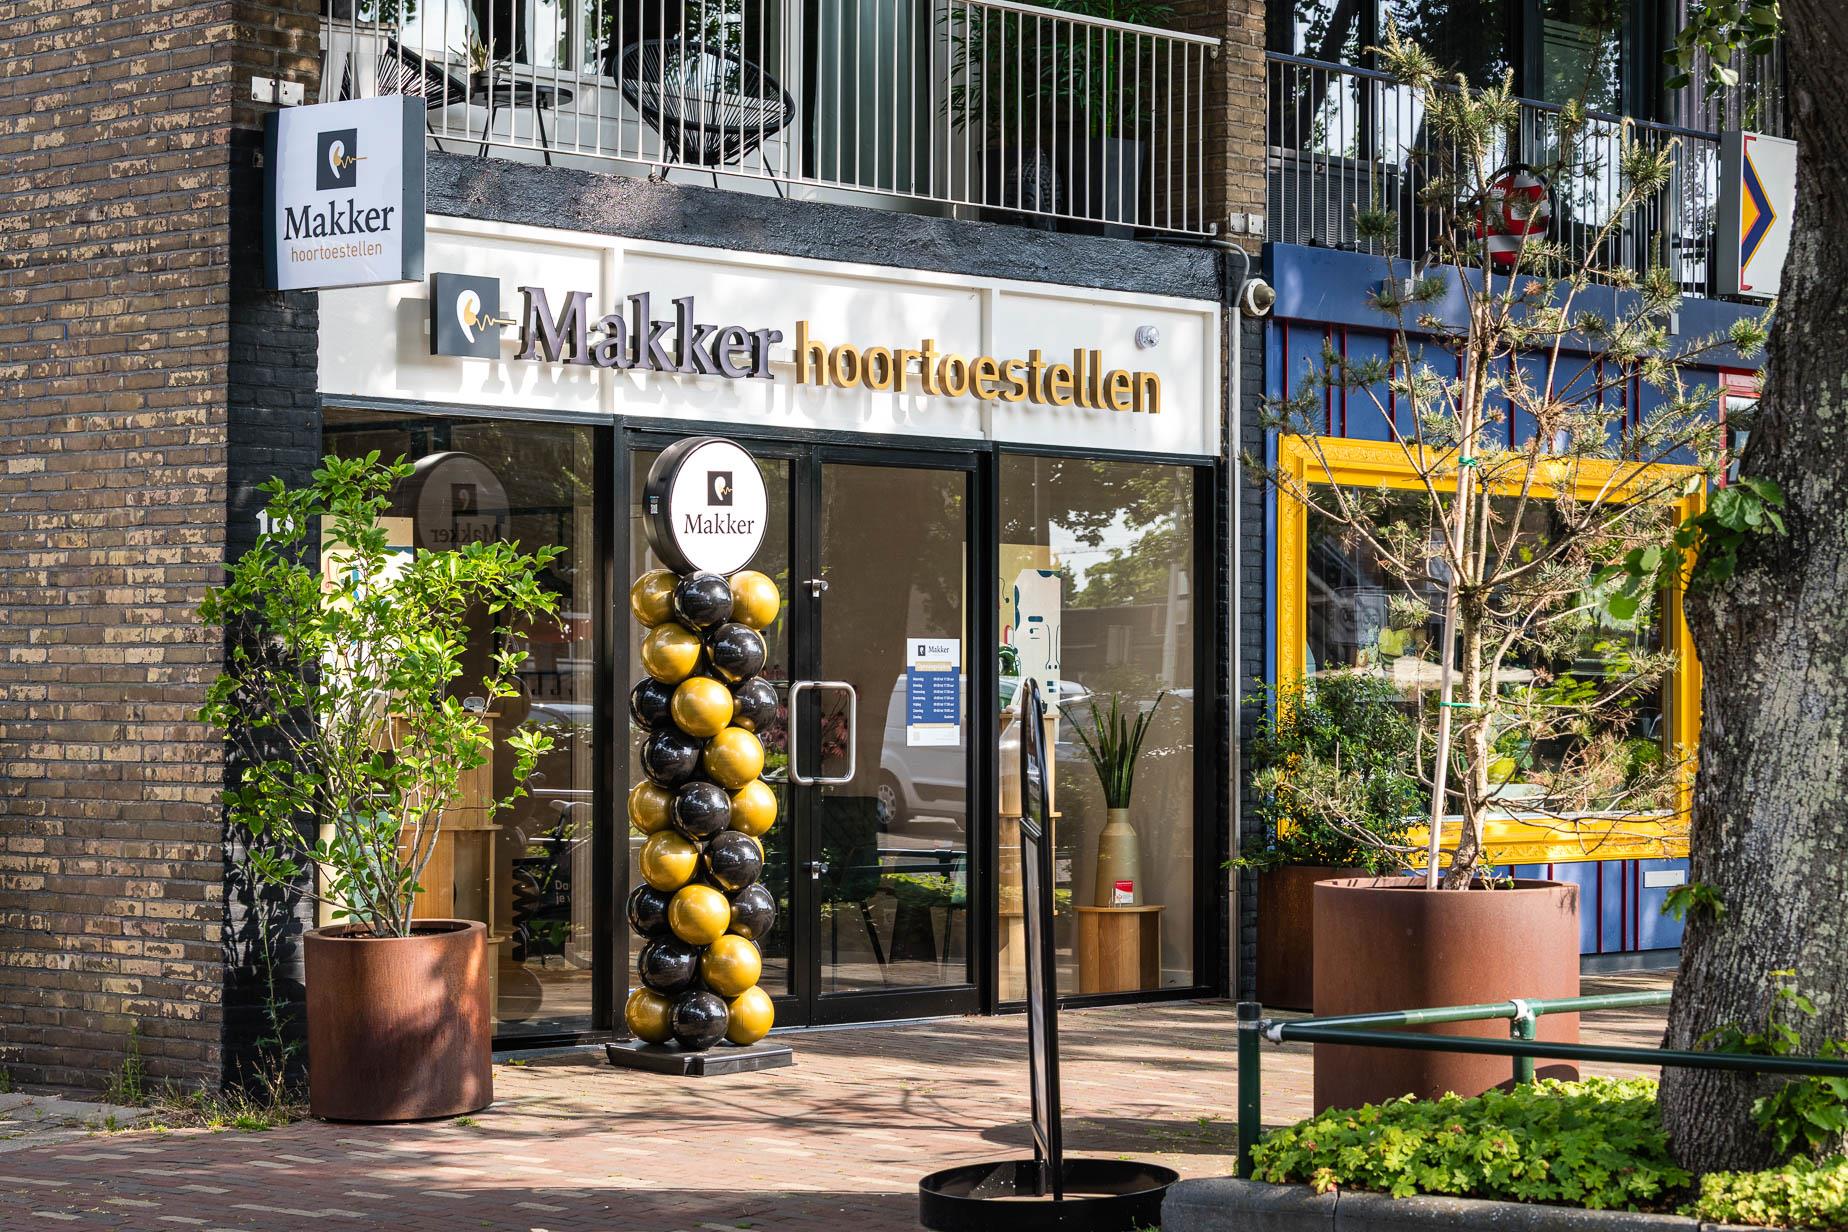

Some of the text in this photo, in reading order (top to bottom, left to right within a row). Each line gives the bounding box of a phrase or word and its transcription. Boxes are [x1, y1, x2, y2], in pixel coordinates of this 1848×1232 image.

[283, 198, 395, 241] Makker
[290, 242, 383, 263] hoortoestellen
[514, 286, 1161, 414] Makker hoortoestellen
[683, 512, 755, 535] Makker
[928, 644, 950, 654] Makker
